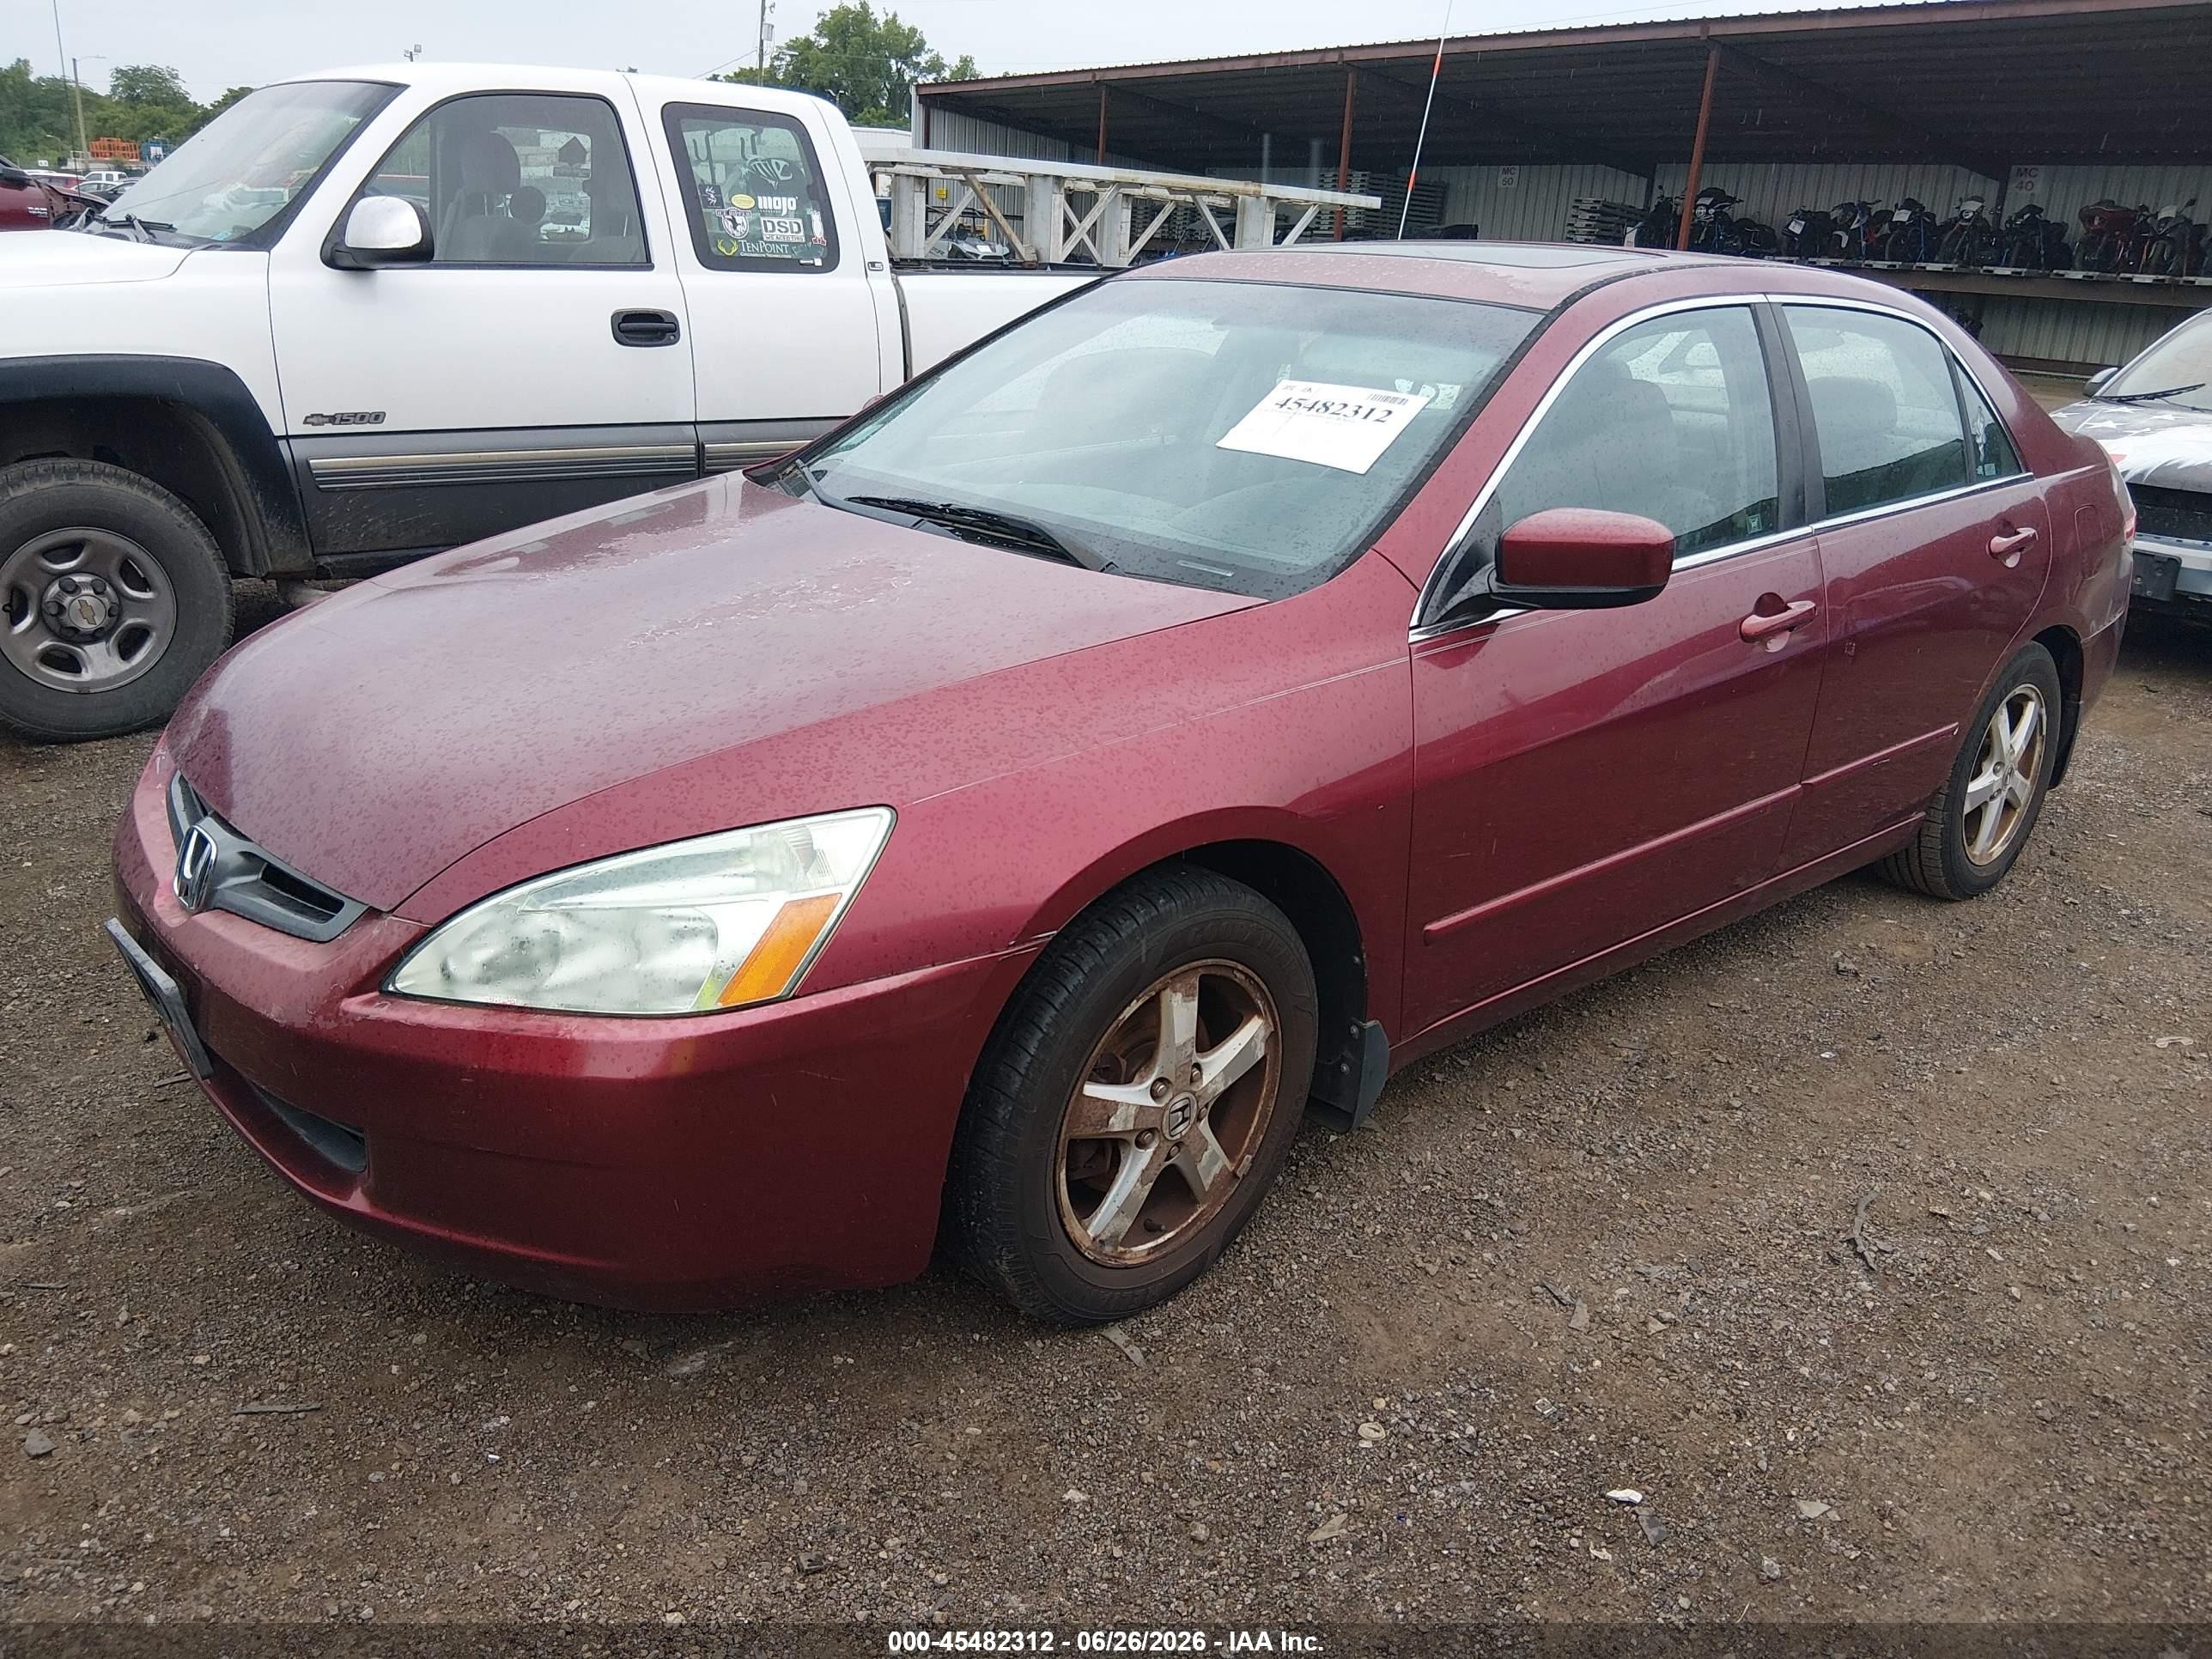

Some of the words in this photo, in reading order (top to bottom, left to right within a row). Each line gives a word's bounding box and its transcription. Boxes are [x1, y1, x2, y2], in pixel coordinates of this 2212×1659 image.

[1502, 167, 1516, 175] MC
[2017, 167, 2039, 178] MC
[2014, 180, 2034, 191] 40
[763, 219, 802, 234] DSD
[1275, 397, 1393, 423] 45482312
[333, 411, 386, 426] 1500
